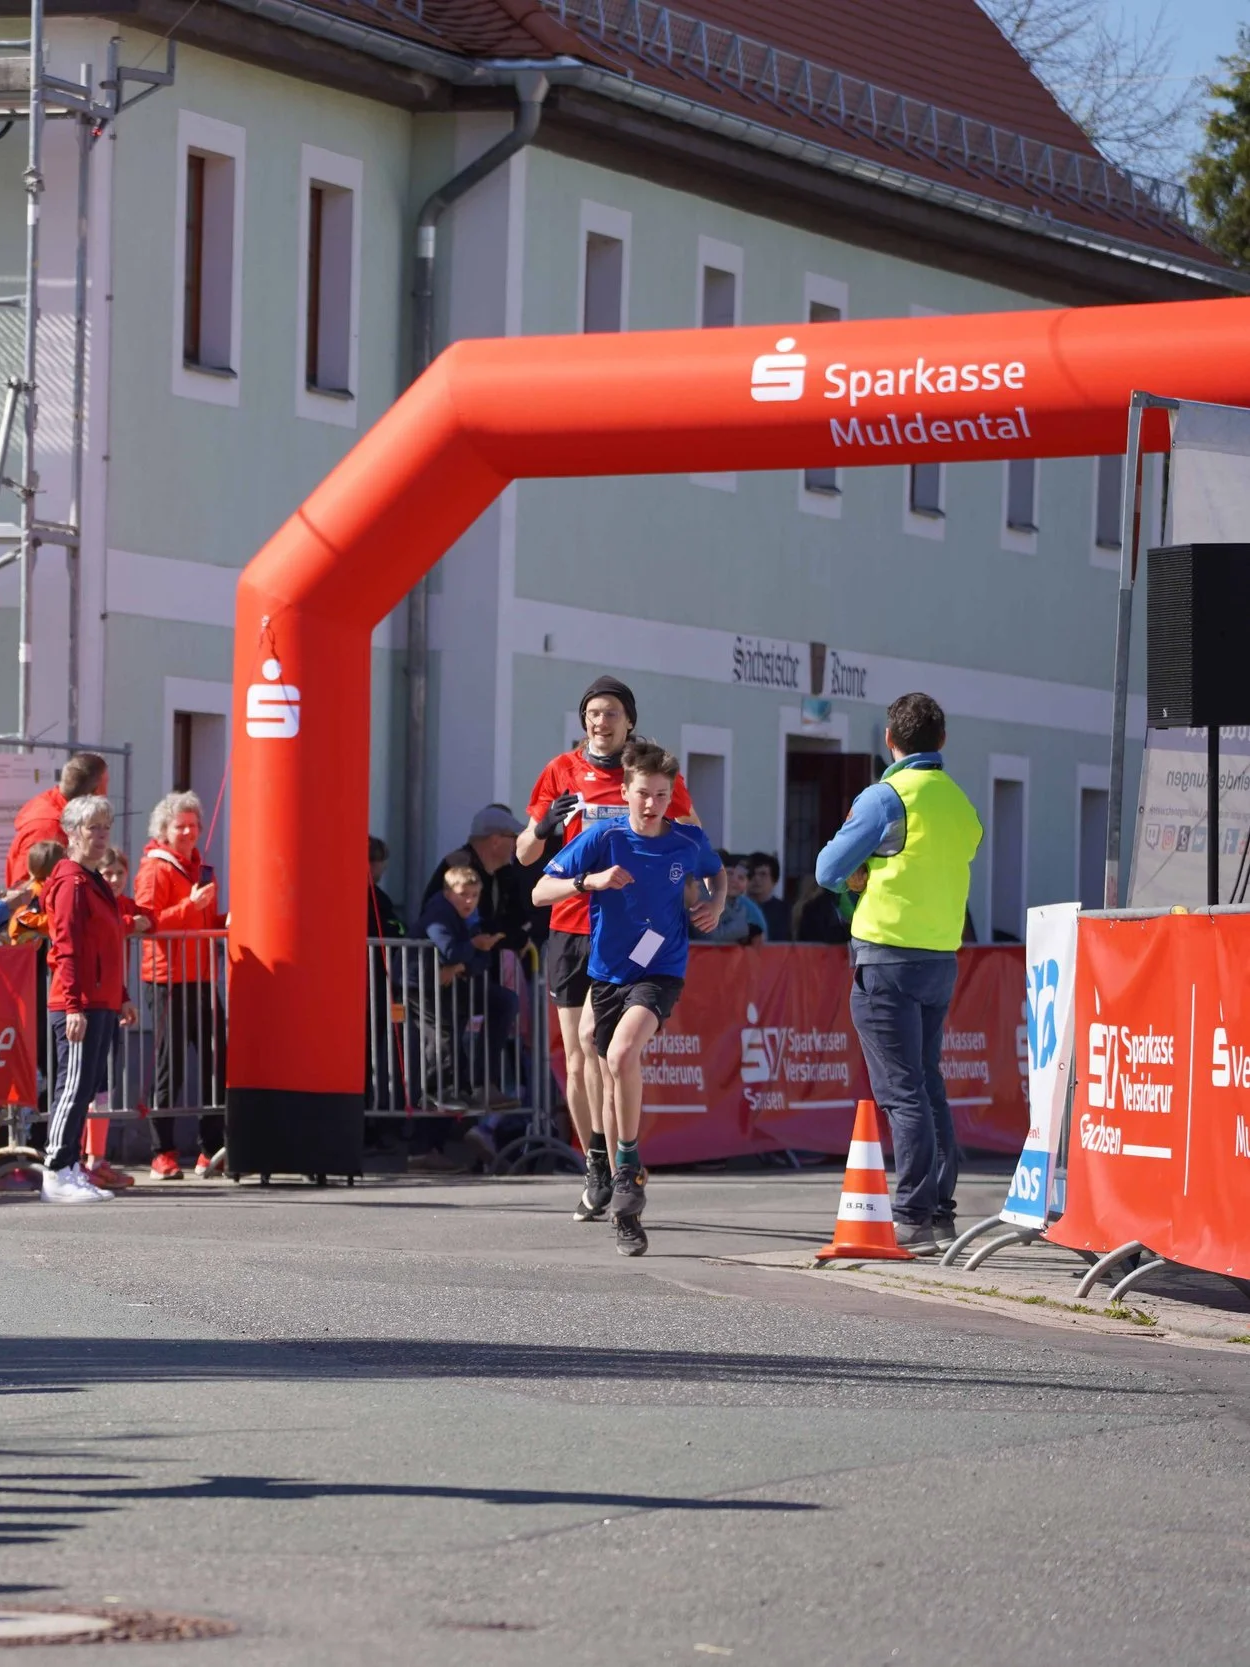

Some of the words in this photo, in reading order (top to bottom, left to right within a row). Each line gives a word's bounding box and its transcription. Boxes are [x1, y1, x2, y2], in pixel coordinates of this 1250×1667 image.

[823, 356, 1027, 407] Sparkasse
[829, 406, 1032, 448] Muldental
[830, 651, 867, 698] Krone
